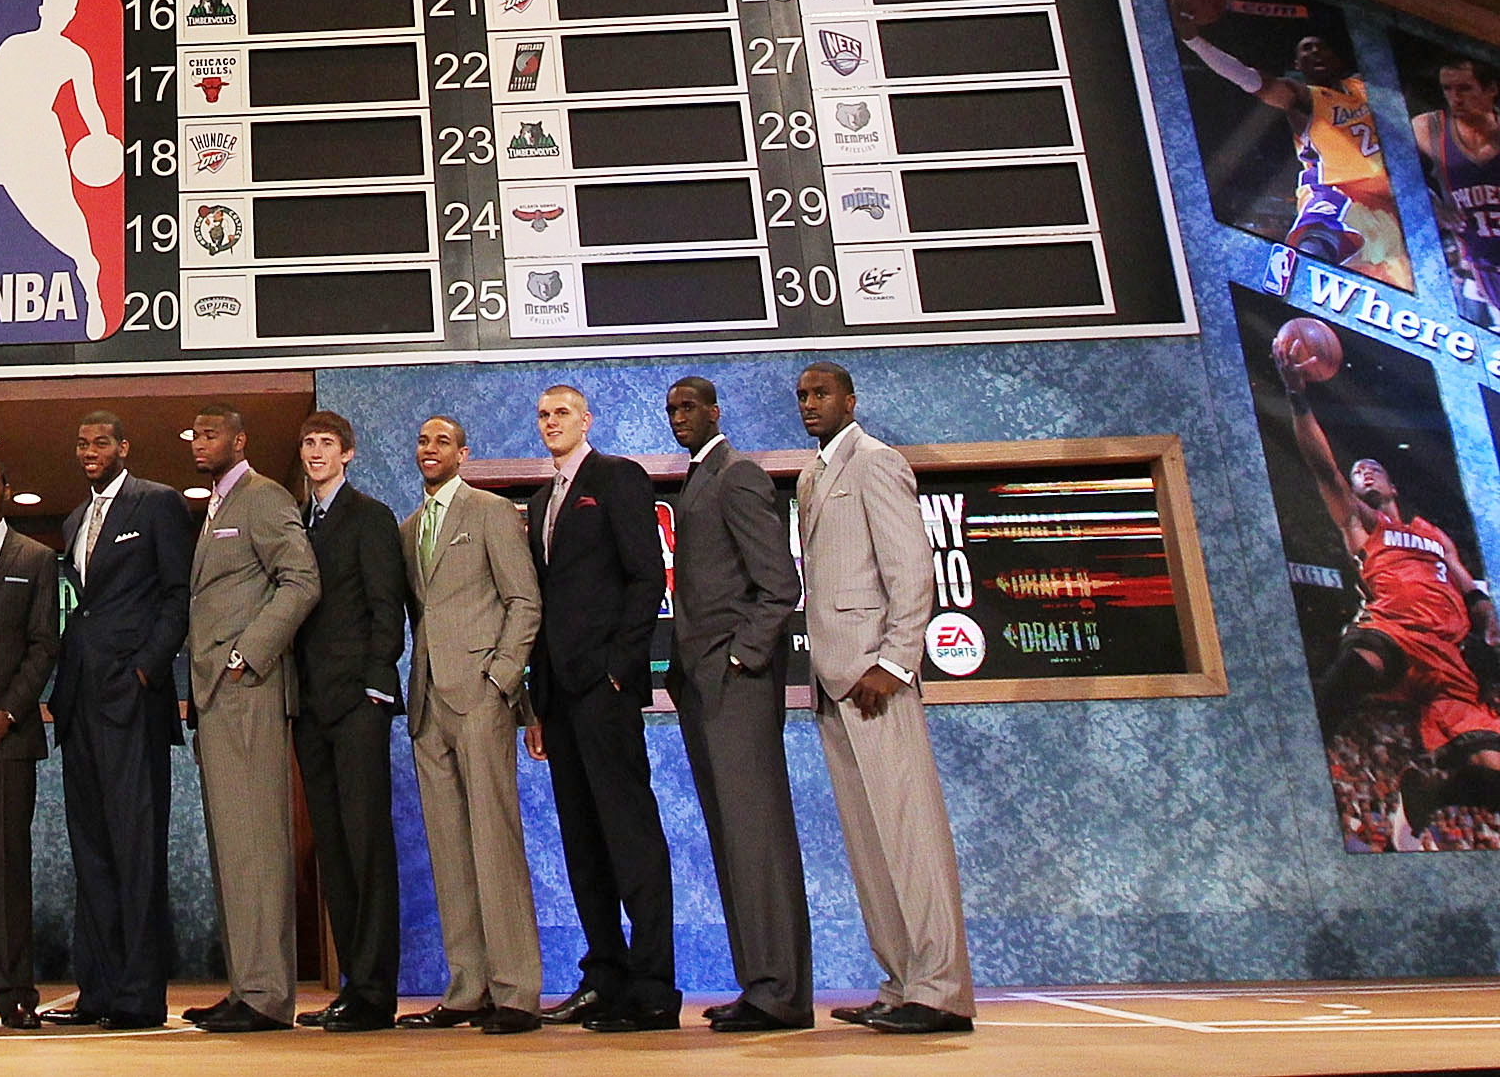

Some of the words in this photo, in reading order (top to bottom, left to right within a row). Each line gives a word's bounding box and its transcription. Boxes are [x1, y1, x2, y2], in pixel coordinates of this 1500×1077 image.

[189, 58, 236, 68] CHICAGO
[748, 37, 803, 75] 27
[825, 32, 860, 57] NETS
[125, 66, 176, 103] 17
[196, 67, 228, 76] BULLS
[434, 51, 489, 90] 22
[190, 132, 238, 152] THUNDER
[438, 126, 495, 165] 23
[758, 111, 816, 150] 28
[834, 131, 879, 145] MEMPHIS
[126, 139, 177, 177] 18
[443, 201, 501, 241] 24
[766, 187, 827, 228] 29
[126, 214, 178, 253] 19
[447, 280, 507, 322] 25
[775, 265, 838, 307] 30
[123, 291, 179, 331] 20
[198, 302, 237, 312] SPURS
[524, 302, 570, 315] MEMPHIS
[1308, 264, 1476, 361] Where
[919, 493, 965, 549] NY
[1383, 529, 1445, 558] MIAMI
[932, 550, 974, 608] 10
[1436, 561, 1448, 583] 3
[936, 647, 977, 658] SPORTS
[937, 626, 973, 647] EA
[1017, 621, 1085, 653] DRAFT
[1086, 633, 1100, 651] 10
